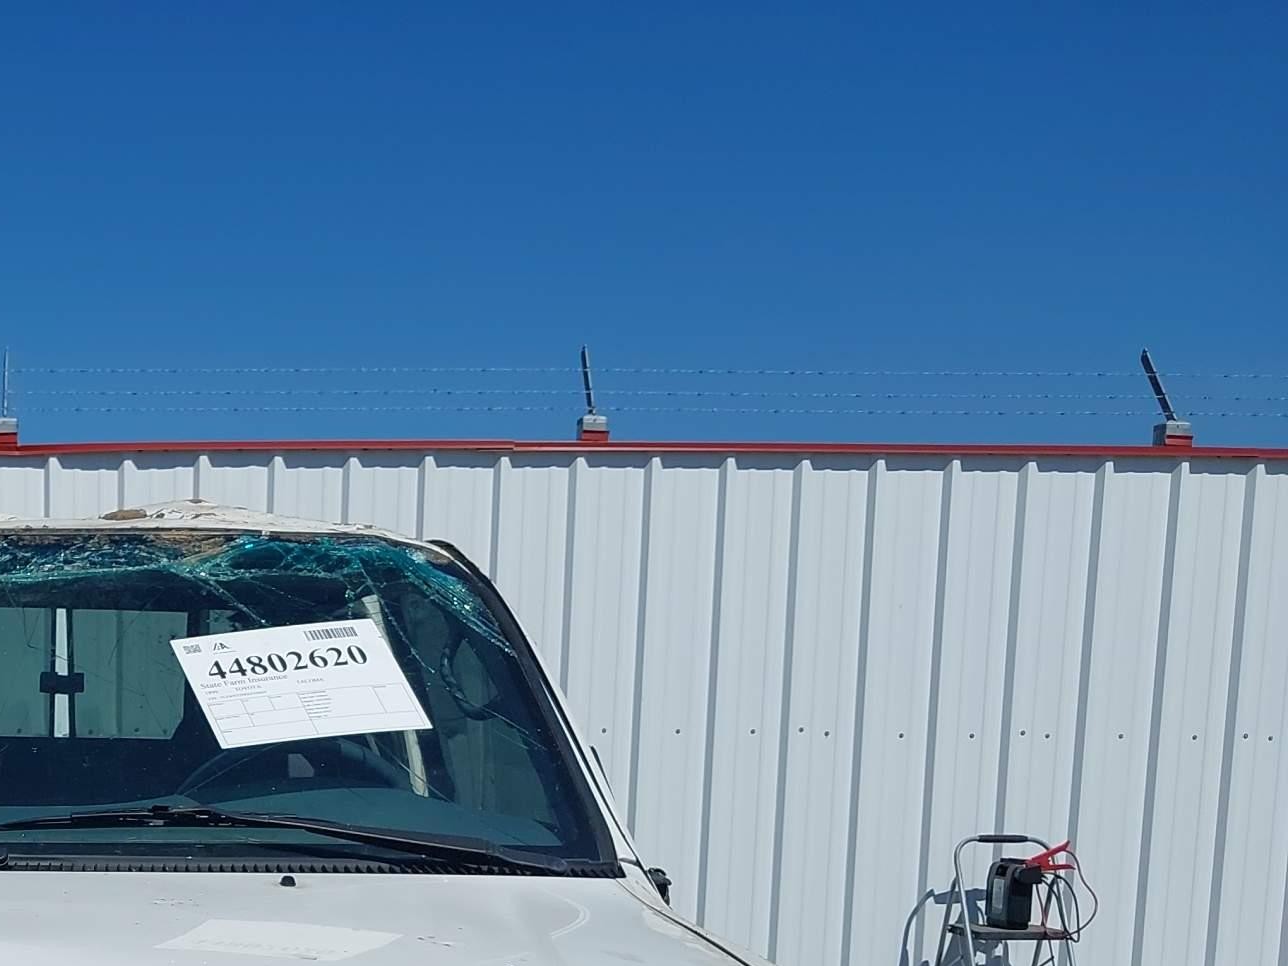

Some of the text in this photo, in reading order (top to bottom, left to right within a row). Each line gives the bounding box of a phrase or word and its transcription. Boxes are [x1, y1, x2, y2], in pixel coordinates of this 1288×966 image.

[208, 644, 368, 680] 44802620
[200, 674, 289, 690] State Farm Insurance
